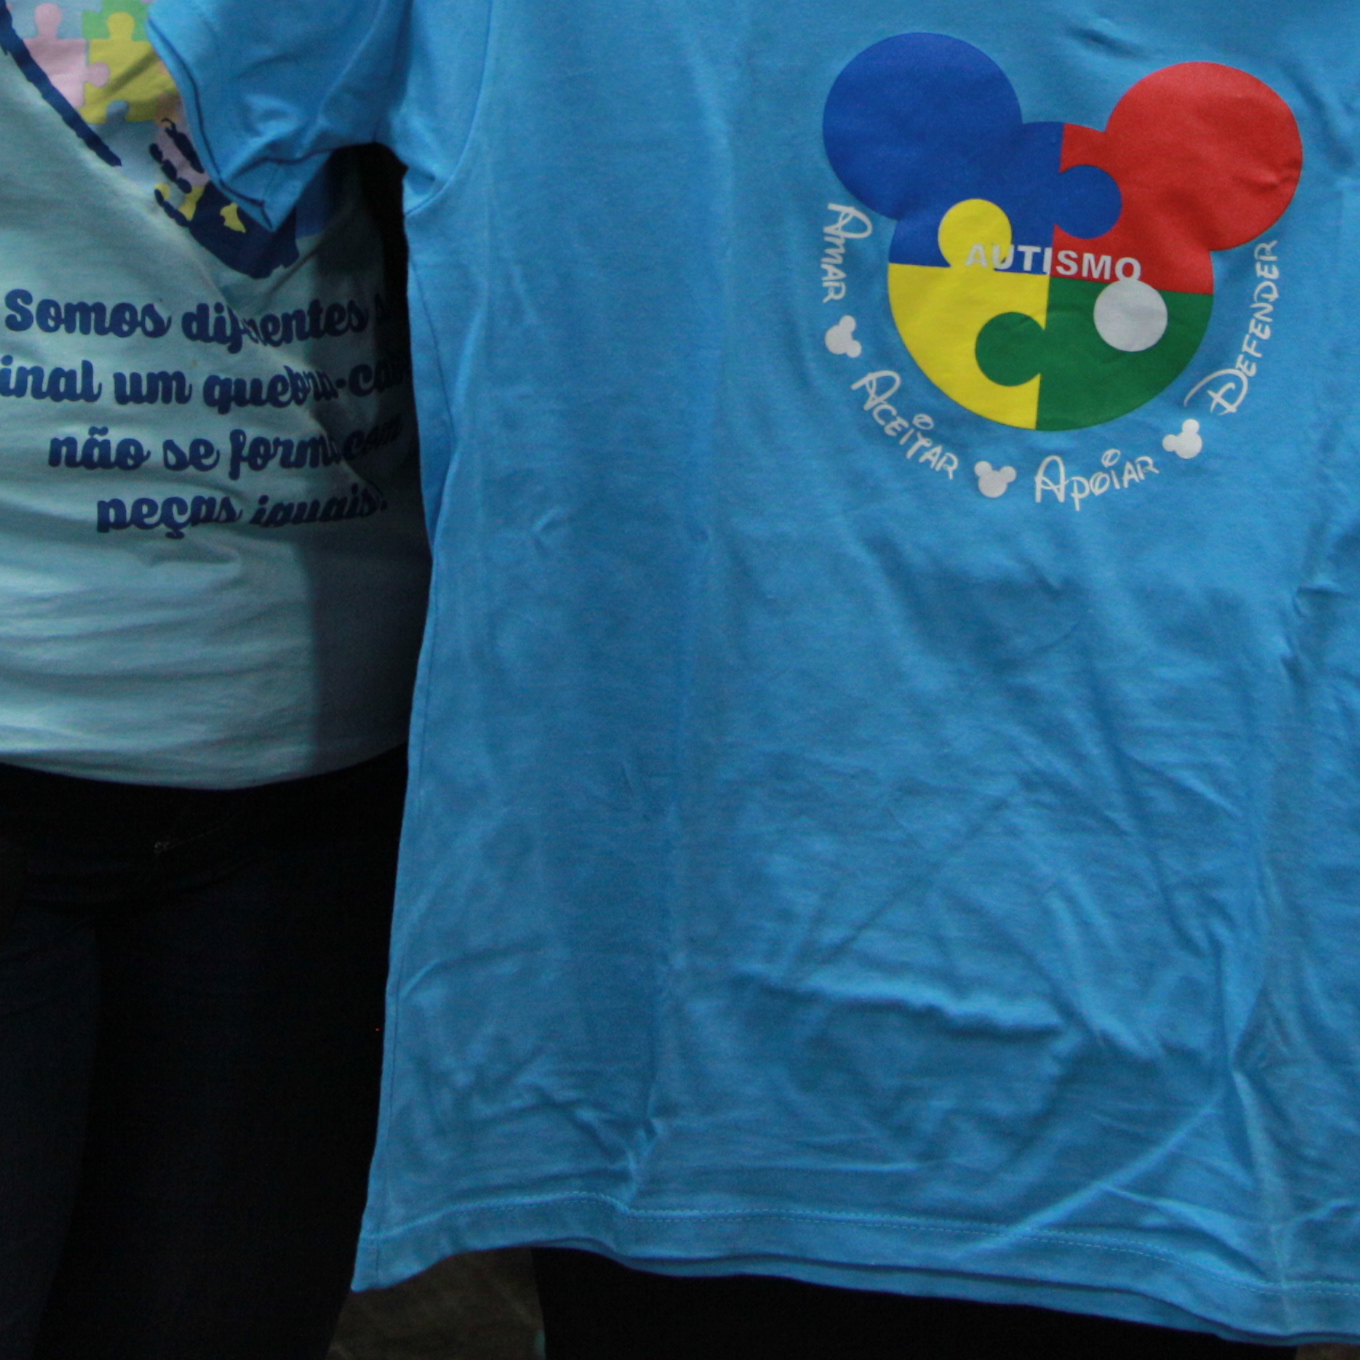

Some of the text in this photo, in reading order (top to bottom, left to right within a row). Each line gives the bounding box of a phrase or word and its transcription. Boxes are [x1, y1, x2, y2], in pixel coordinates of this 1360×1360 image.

[964, 243, 1142, 283] AUTISMO
[4, 288, 172, 338] Somos
[112, 370, 193, 405] um
[48, 426, 151, 471] não
[162, 437, 220, 472] se
[96, 495, 243, 539] peças
